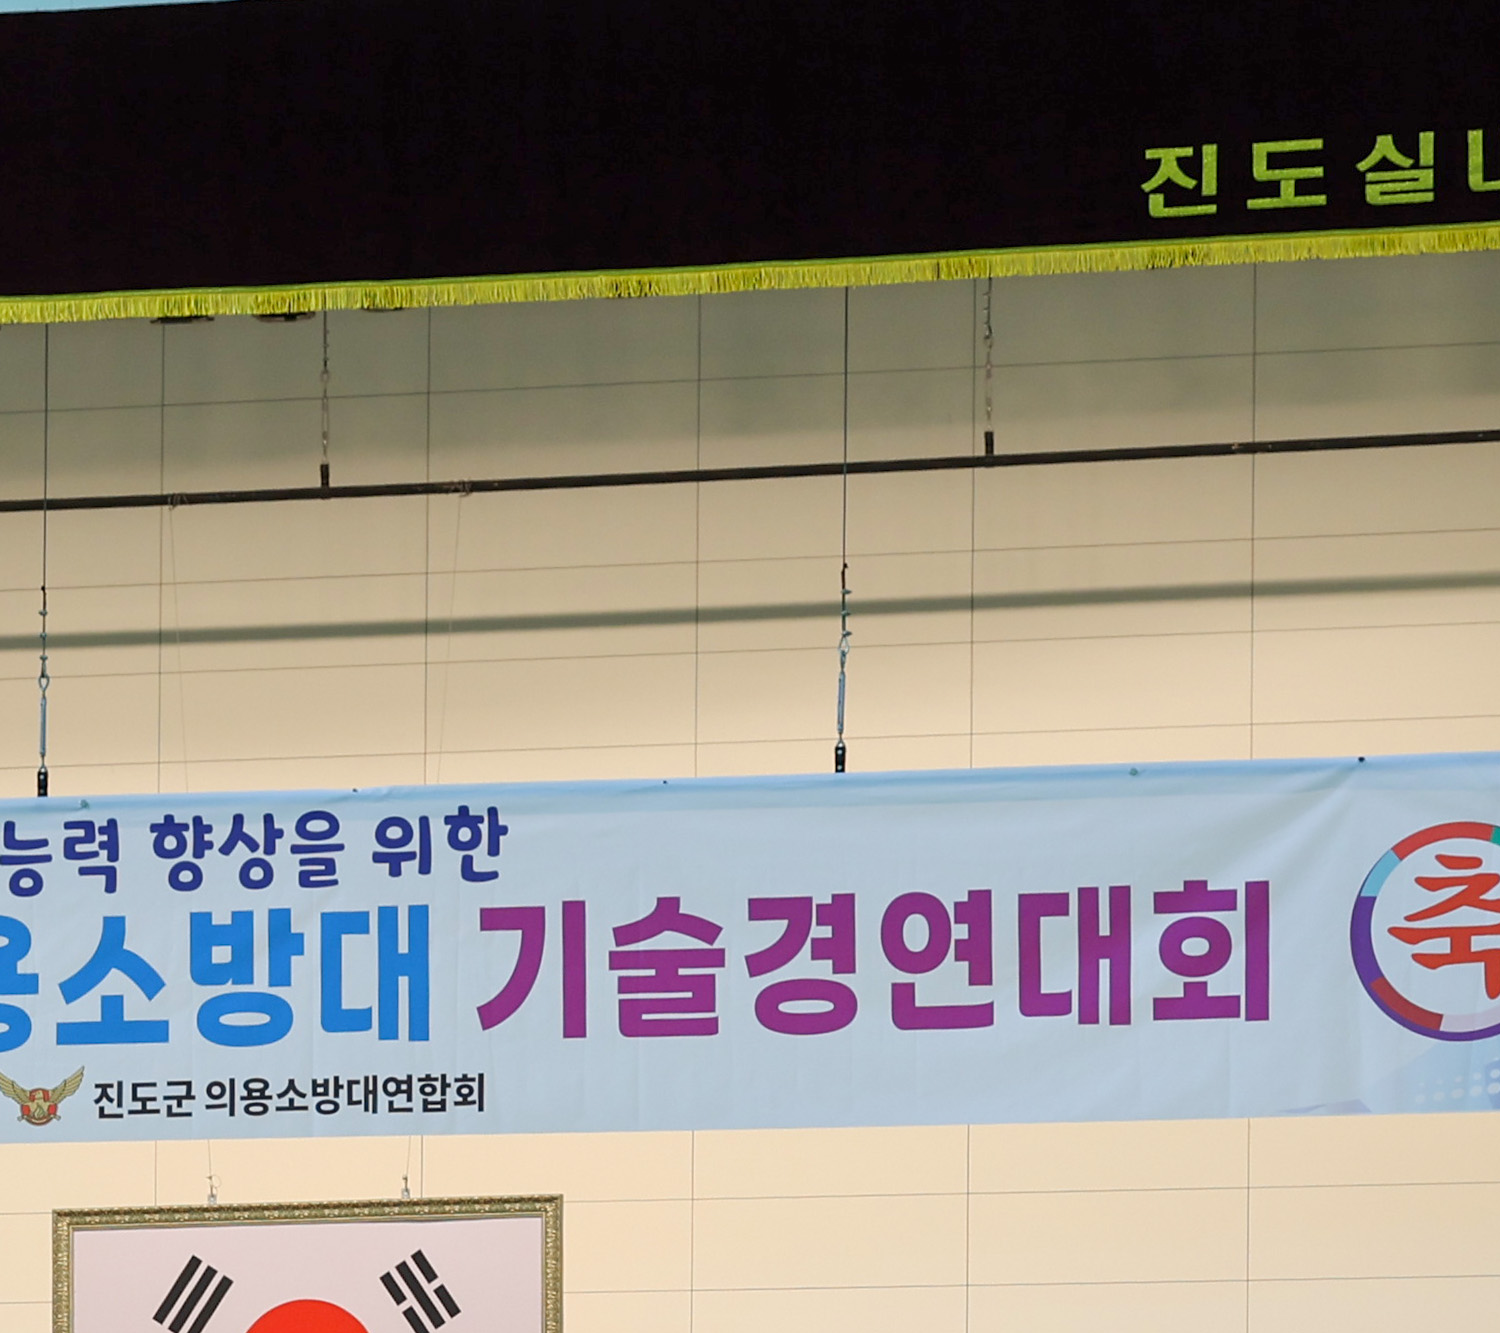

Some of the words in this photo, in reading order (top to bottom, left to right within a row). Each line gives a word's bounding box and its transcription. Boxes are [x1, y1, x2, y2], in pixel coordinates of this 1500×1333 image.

[150, 811, 344, 891] 향상을
[372, 805, 508, 882] 위한
[477, 880, 1269, 1038] 기술경연대회
[94, 1080, 197, 1118] 진도군
[205, 1073, 485, 1116] 의용소방대연합회
